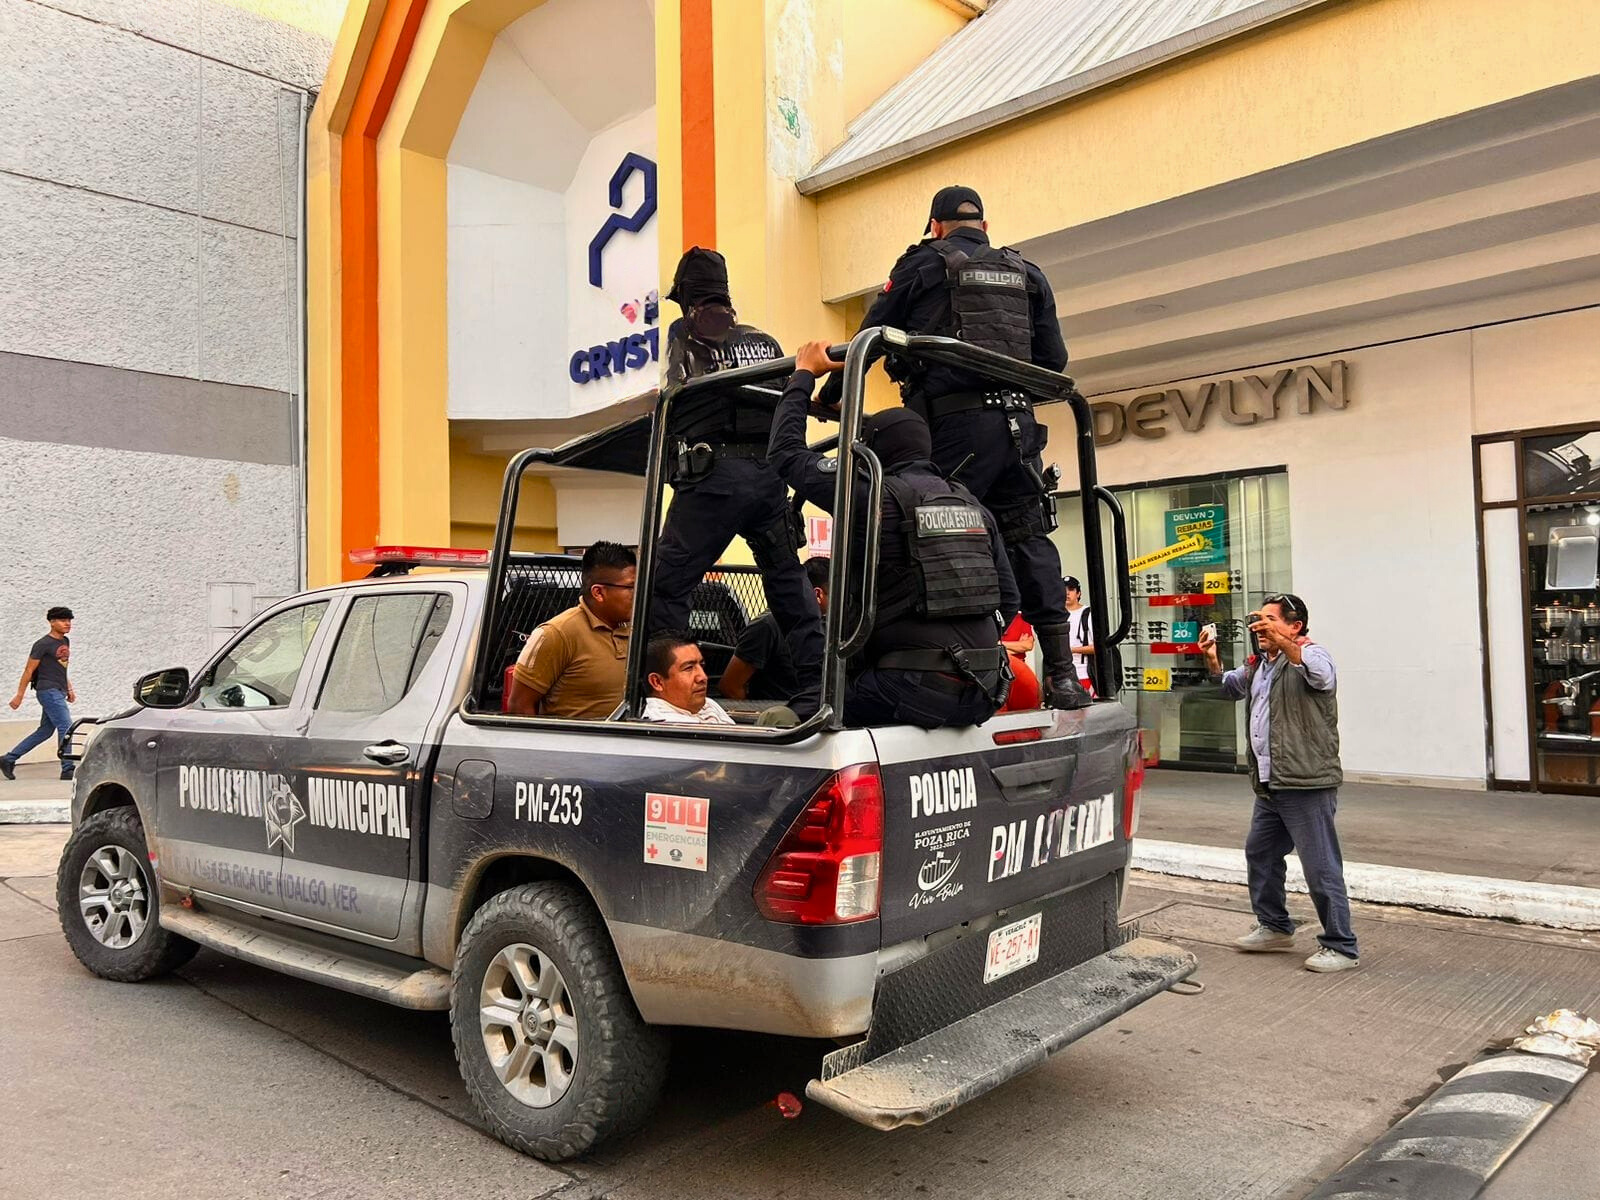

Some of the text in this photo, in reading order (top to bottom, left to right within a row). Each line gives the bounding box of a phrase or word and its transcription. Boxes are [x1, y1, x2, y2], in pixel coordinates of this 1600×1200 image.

[1090, 359, 1350, 448] DEVLYN
[1173, 511, 1206, 521] DEVLYN
[1176, 521, 1213, 534] REBAJAS
[1147, 551, 1171, 564] REBAJAS
[1171, 541, 1197, 553] REBAJAS
[515, 781, 583, 826] PM-253
[909, 767, 977, 819] POLICIA
[307, 777, 410, 840] MUNICIPAL
[649, 797, 703, 820] 911
[646, 832, 706, 847] EMERGENCIAS
[914, 828, 971, 850] POZA RICA
[258, 869, 274, 896] DE
